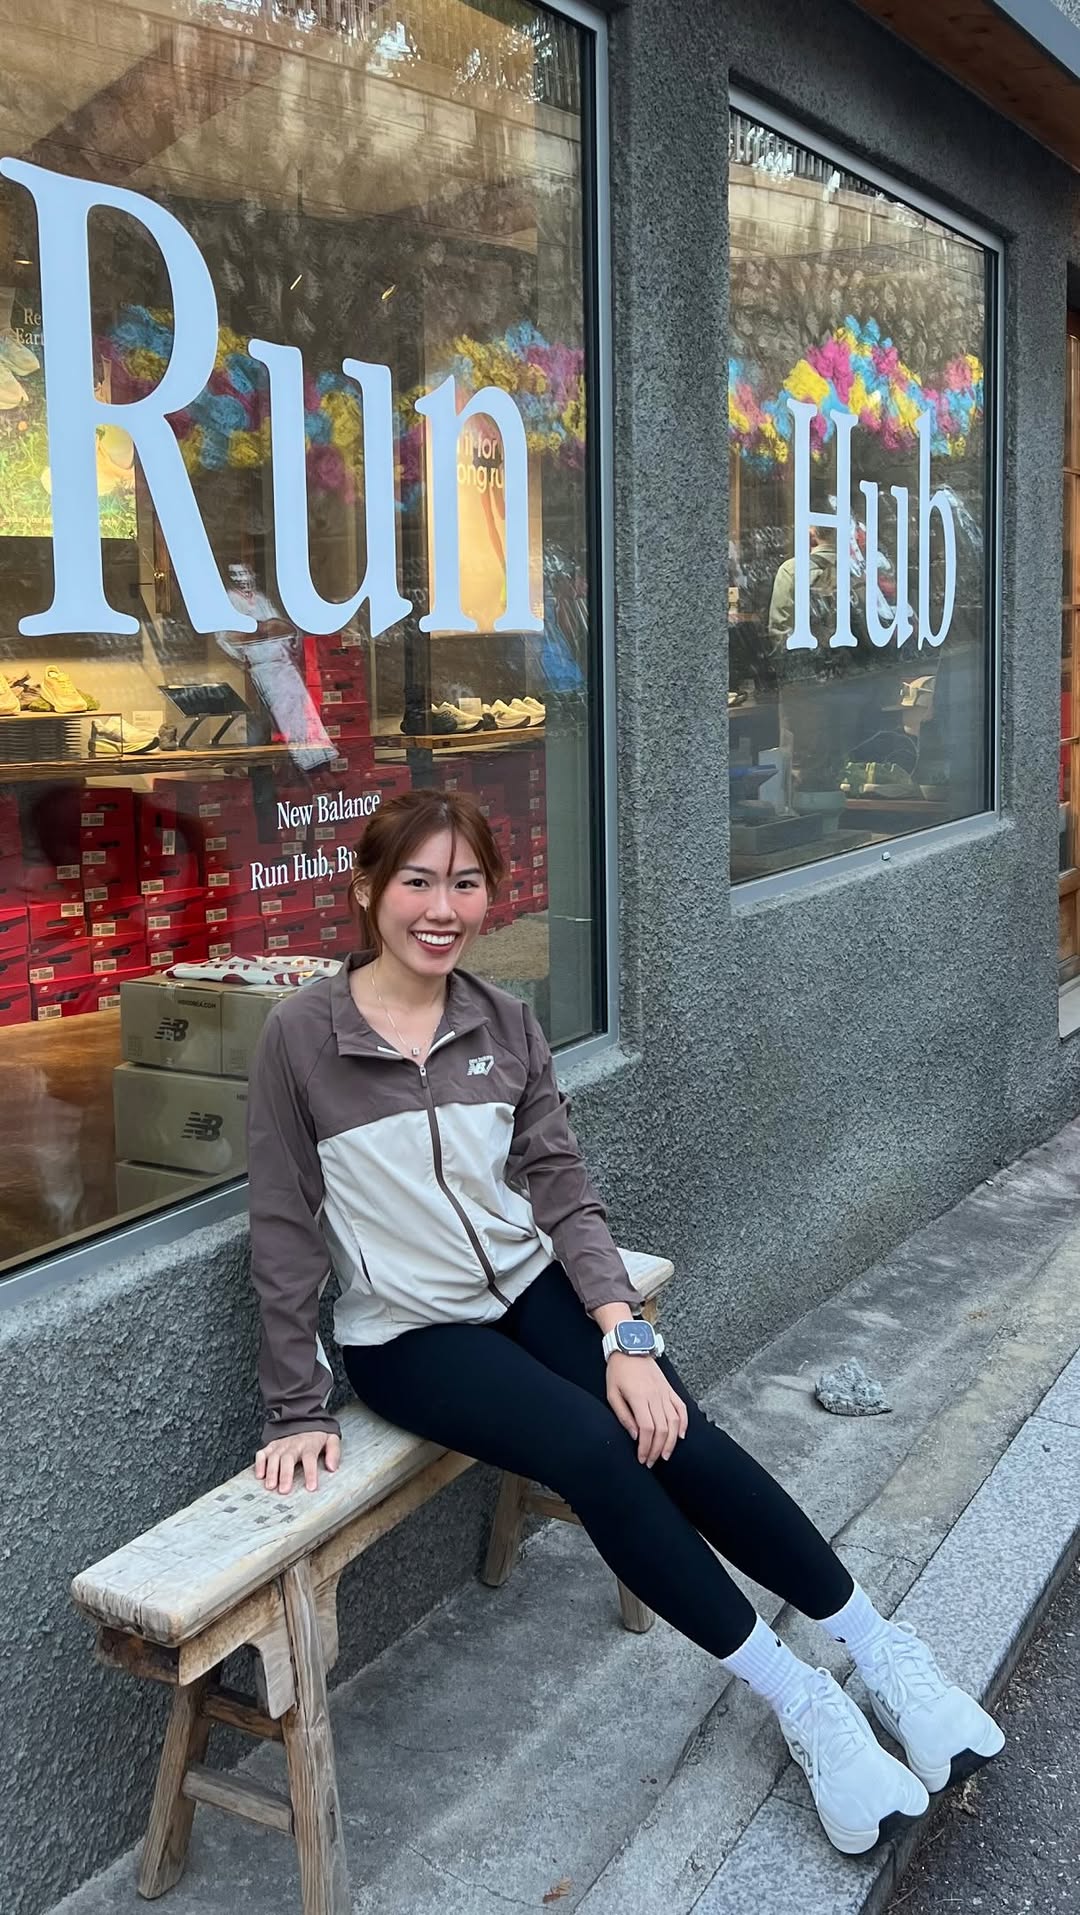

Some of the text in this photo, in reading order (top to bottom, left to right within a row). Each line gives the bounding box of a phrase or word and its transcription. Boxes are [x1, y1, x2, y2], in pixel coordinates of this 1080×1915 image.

[0, 157, 544, 637] Run
[456, 463, 487, 494] ong
[786, 399, 957, 651] Hub
[277, 791, 381, 830] New Balance
[250, 862, 289, 891] Run
[293, 847, 334, 882] Hub,
[336, 846, 358, 873] Bu
